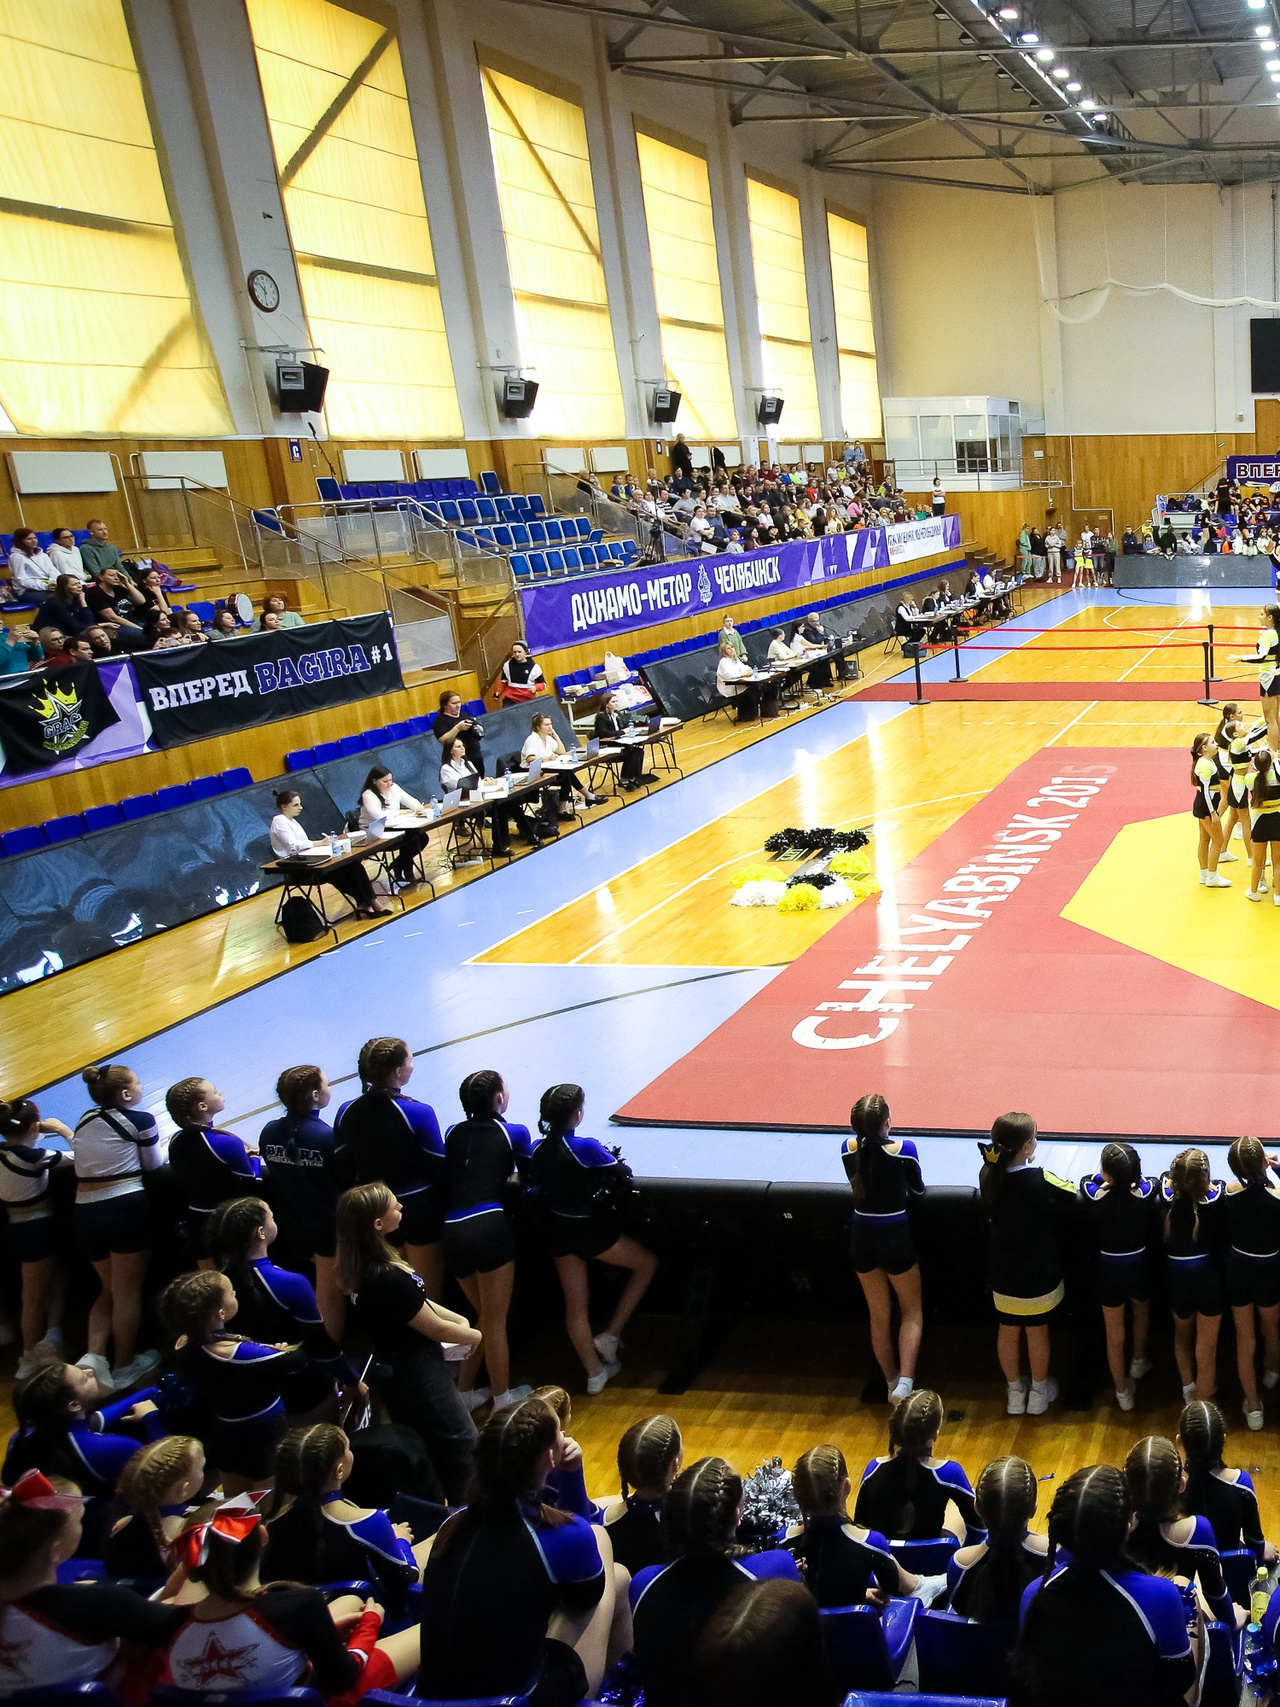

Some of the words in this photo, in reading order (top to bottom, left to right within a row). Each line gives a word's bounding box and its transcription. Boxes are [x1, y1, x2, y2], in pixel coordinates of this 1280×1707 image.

[571, 573, 693, 632] ДИНАМО-МЕТАР
[713, 556, 781, 594] ЧЕЛЯБИНСК
[149, 669, 253, 711] ВПЕРЕД
[253, 644, 372, 695] BAGIRA
[371, 643, 393, 665] #1
[791, 813, 1080, 1050] CHELYABINSK
[1025, 765, 1118, 808] 2015
[265, 1144, 324, 1162] BARA
